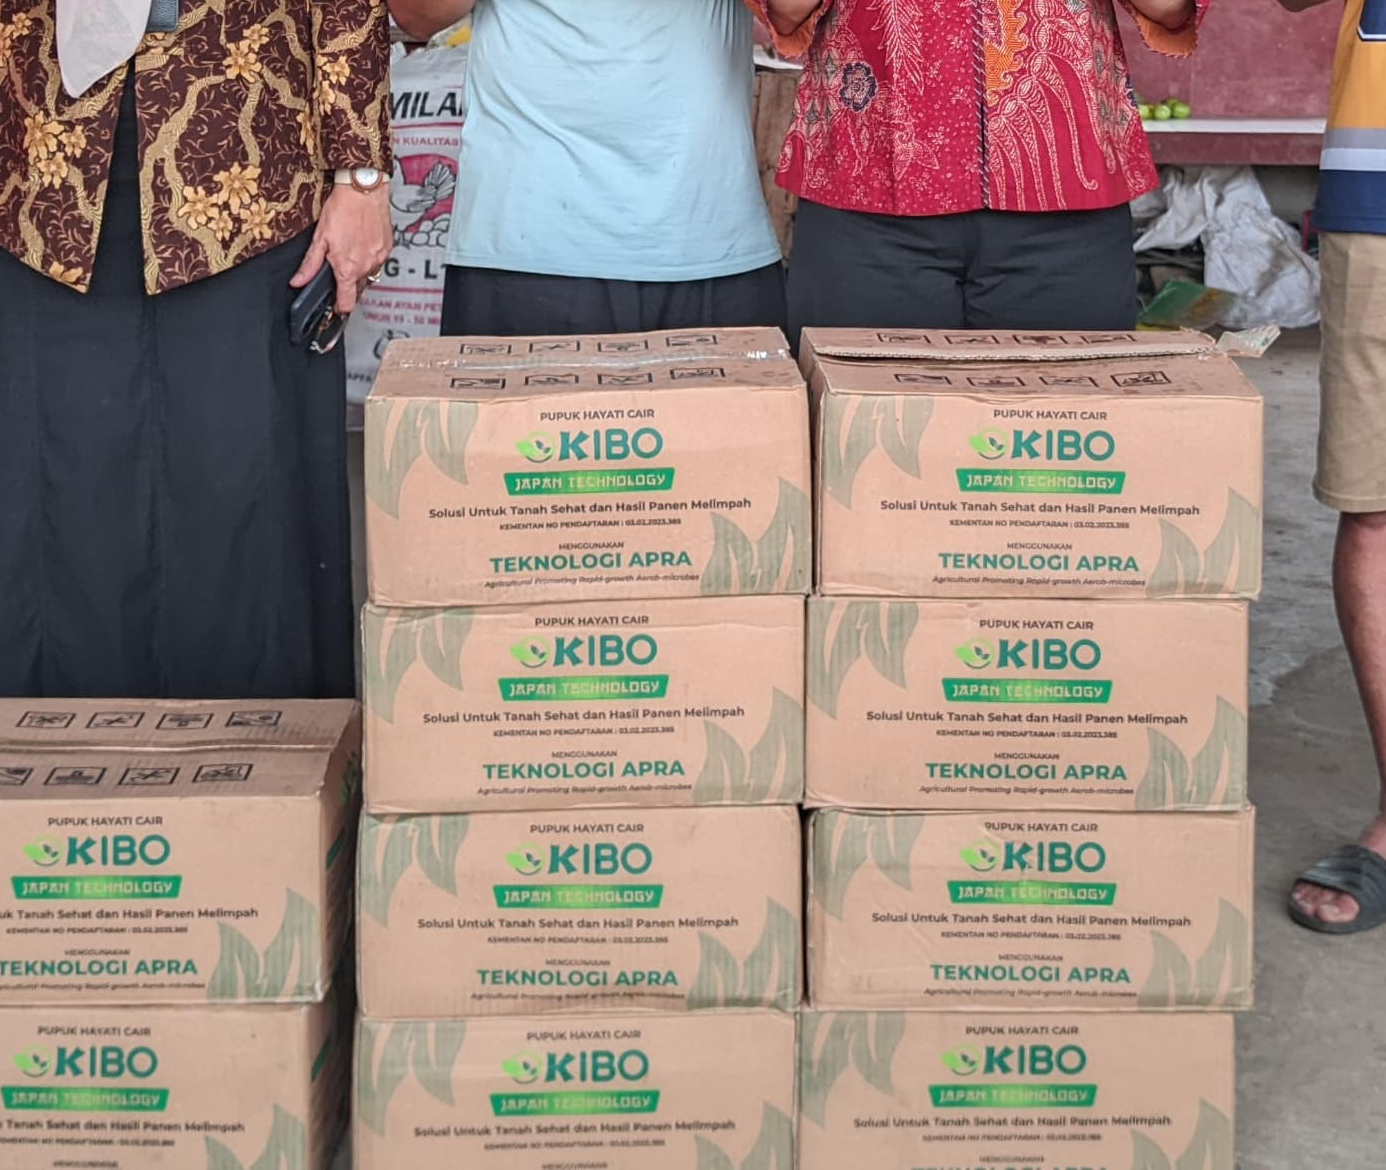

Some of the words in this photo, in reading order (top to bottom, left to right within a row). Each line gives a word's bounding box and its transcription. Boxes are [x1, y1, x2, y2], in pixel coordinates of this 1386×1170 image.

[390, 91, 463, 120] MILA
[403, 136, 459, 147] KUALITAS
[540, 410, 580, 421] PUPUK
[583, 409, 624, 420] HAYATI
[626, 408, 654, 419] CAIR
[993, 409, 1034, 420] PUPUK
[1036, 409, 1077, 420] HAYATI
[1079, 410, 1107, 421] CAIR
[558, 426, 663, 461] KIBO
[1010, 427, 1115, 462] KIBO
[514, 476, 562, 490] JAPAN
[568, 473, 665, 489] TECHNOLOGY
[966, 474, 1013, 487] JAPAN
[1018, 474, 1116, 490] TECHNOLOGY
[428, 506, 465, 519] Solusi
[469, 505, 506, 517] Untuk
[509, 504, 547, 515] Tanah
[550, 502, 586, 514] Sehat
[589, 501, 612, 513] dan
[615, 500, 645, 512] Hasil
[649, 500, 687, 511] Panen
[690, 497, 751, 512] Melimpah
[880, 498, 917, 511] Solusi
[920, 500, 957, 512] Untuk
[960, 501, 997, 512] Tanah
[1000, 501, 1036, 513] Sehat
[1038, 502, 1062, 513] dan
[1065, 502, 1095, 514] Hasil
[1098, 504, 1136, 515] Panen
[1139, 504, 1200, 519] Melimpah
[489, 553, 621, 573] TEKNOLOGI
[628, 551, 692, 568] APRA
[938, 552, 1069, 571] TEKNOLOGI
[1075, 554, 1139, 571] APRA
[535, 616, 575, 627] PUPUK
[578, 615, 618, 626] HAYATI
[621, 615, 649, 625] CAIR
[979, 618, 1019, 629] PUPUK
[1022, 618, 1063, 629] HAYATI
[1066, 619, 1094, 630] CAIR
[553, 633, 657, 667] KIBO
[996, 636, 1102, 671] KIBO
[508, 683, 556, 696] JAPAN
[562, 680, 659, 696] TECHNOLOGY
[952, 684, 1000, 697] JAPAN
[1005, 684, 1103, 699] TECHNOLOGY
[482, 762, 614, 780] TEKNOLOGI
[621, 760, 685, 777] APRA
[925, 762, 1056, 781] TEKNOLOGI
[1063, 764, 1127, 781] APRA
[47, 816, 88, 826] PUPUK
[90, 815, 132, 825] HAYATI
[134, 815, 162, 825] CAIR
[65, 834, 171, 866] KIBO
[547, 842, 652, 875] KIBO
[1002, 839, 1105, 874] KIBO
[21, 881, 69, 894] JAPAN
[75, 881, 172, 895] TECHNOLOGY
[503, 890, 551, 903] JAPAN
[556, 889, 653, 904] TECHNOLOGY
[957, 885, 1005, 899] JAPAN
[1010, 886, 1106, 902] TECHNOLOGY
[134, 960, 197, 975] APRA
[928, 964, 1061, 983] TEKNOLOGI
[1067, 966, 1130, 983] APRA
[476, 970, 608, 987] TEKNOLOGI
[614, 970, 678, 986] APRA
[54, 1044, 158, 1079] KIBO
[544, 1048, 650, 1082] KIBO
[983, 1043, 1087, 1075] KIBO
